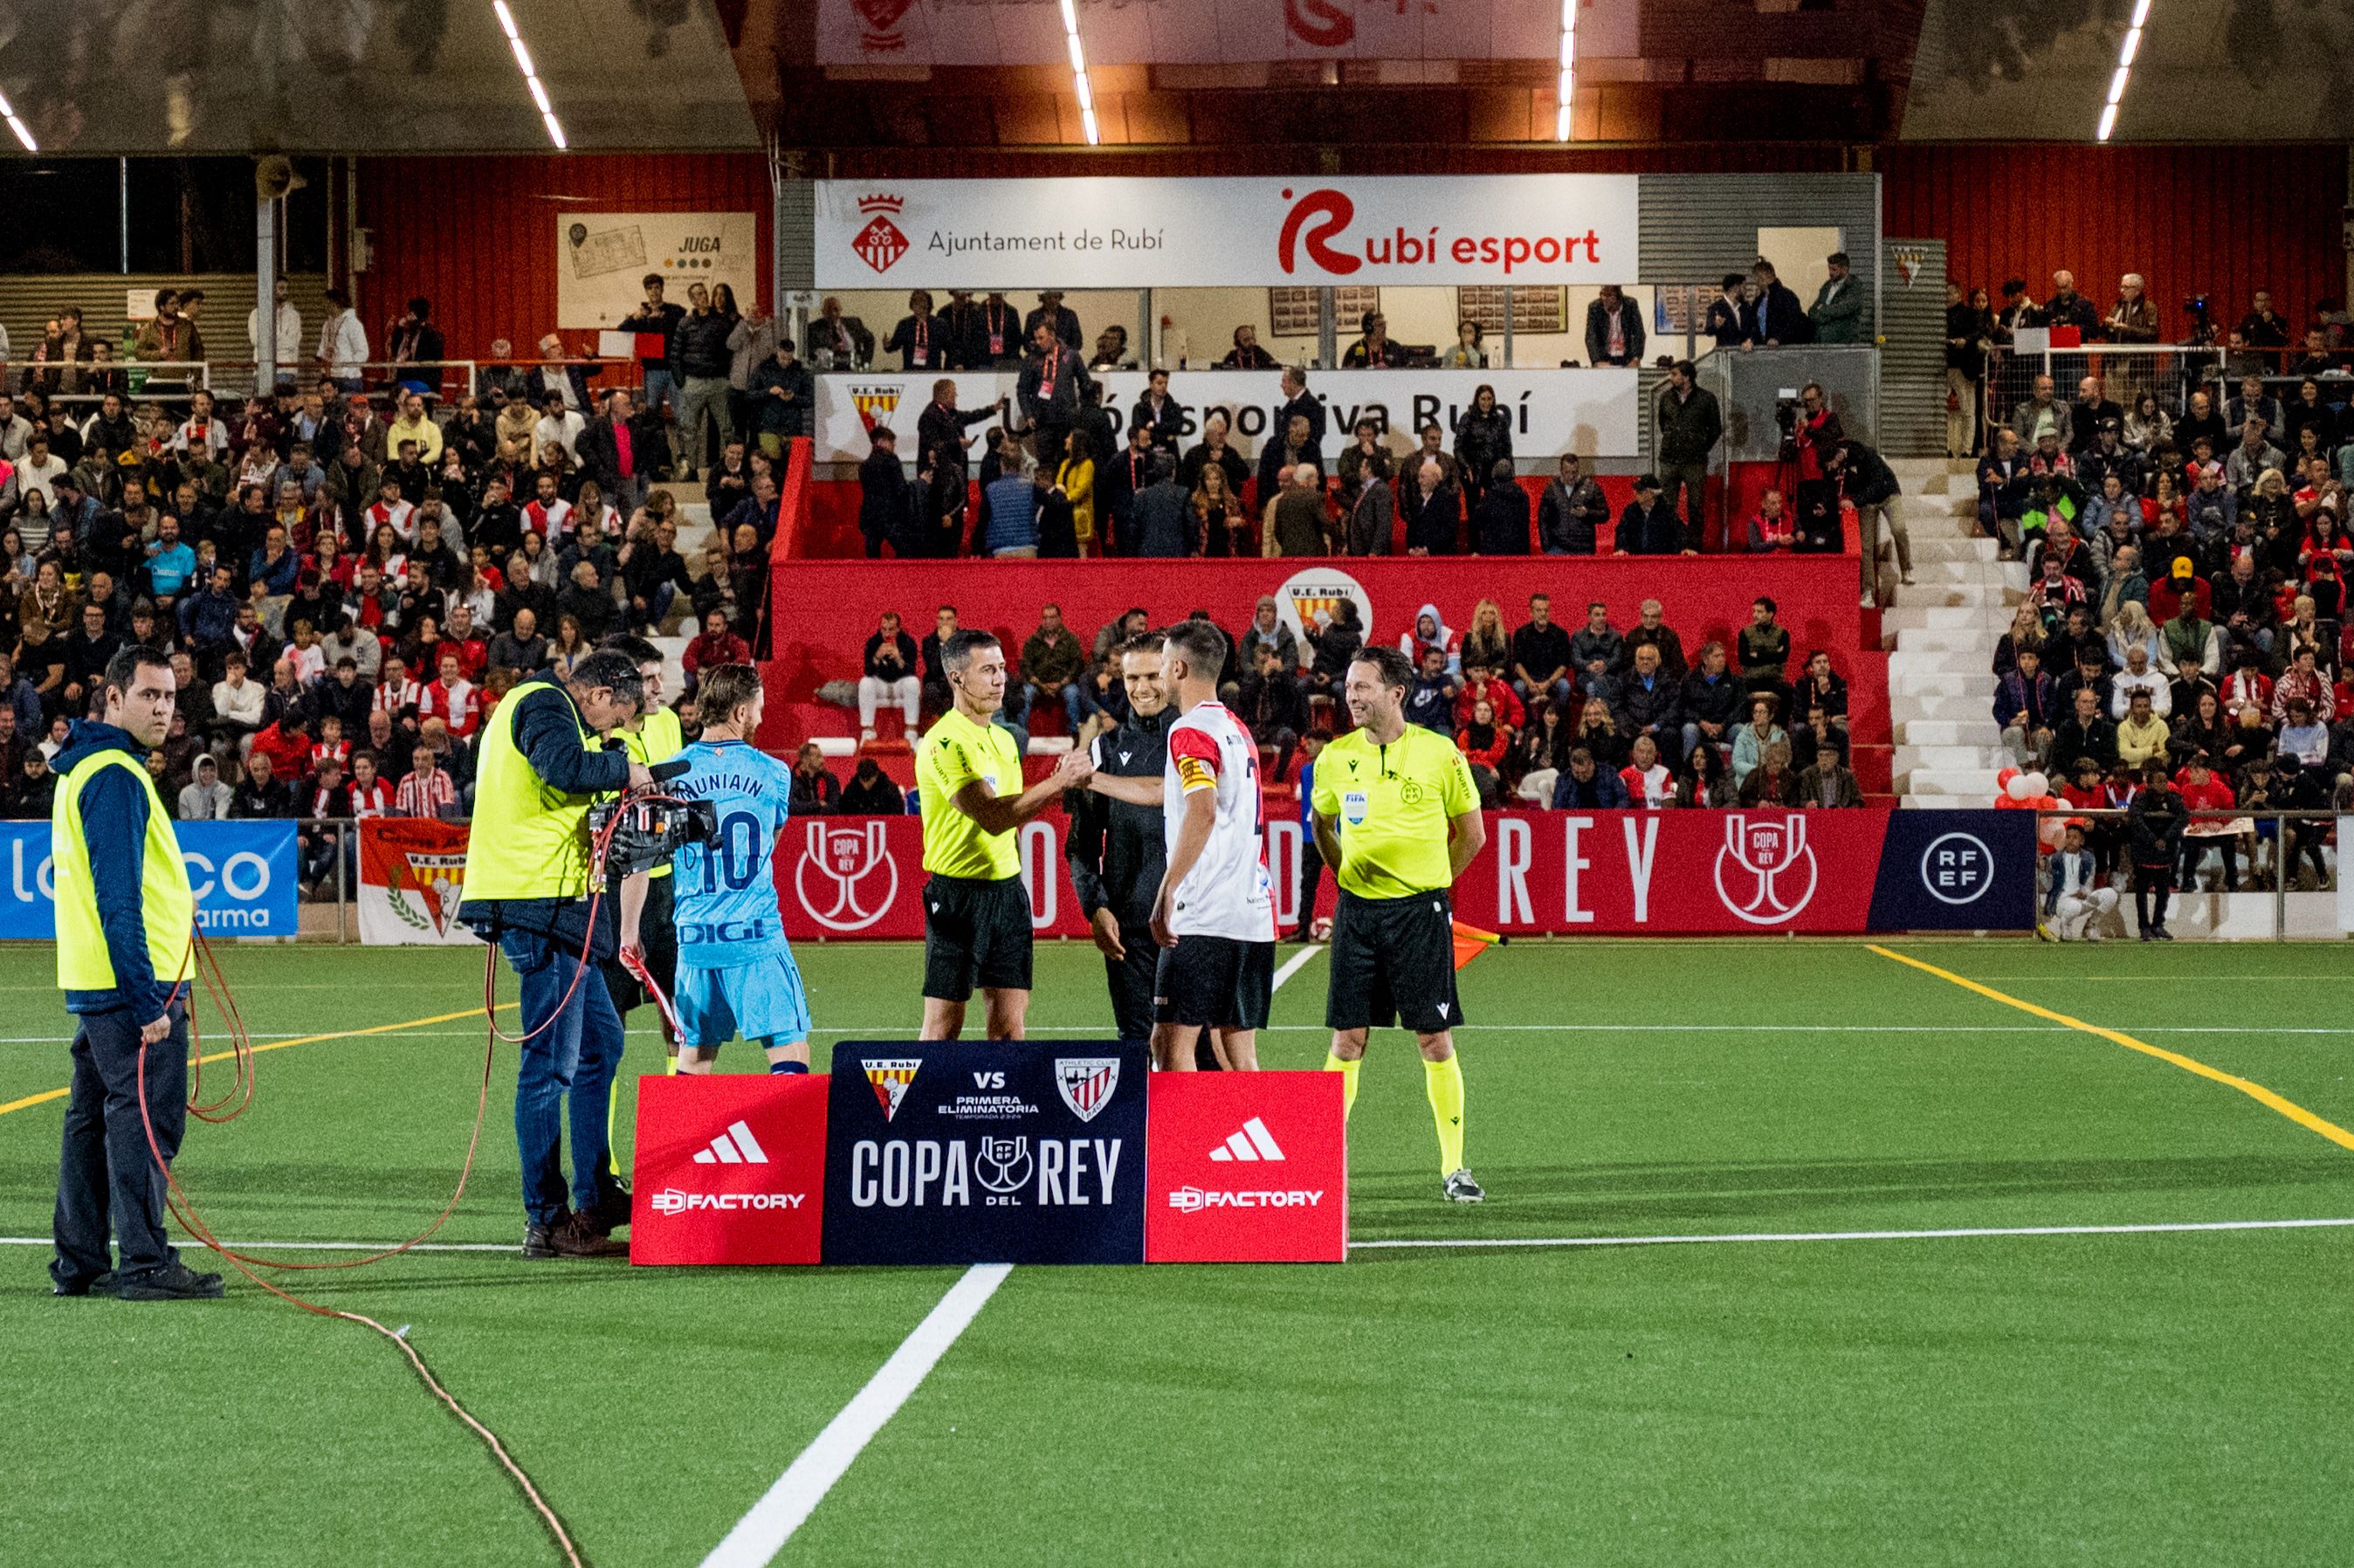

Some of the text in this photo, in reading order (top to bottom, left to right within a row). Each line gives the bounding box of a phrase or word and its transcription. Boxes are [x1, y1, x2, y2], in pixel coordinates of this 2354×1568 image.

[1278, 188, 1600, 275] Rubí esport
[678, 237, 720, 253] JUGA
[928, 229, 1164, 256] Ajuntament de Rubí
[834, 838, 859, 856] COPA
[1753, 832, 1779, 849] COPA
[439, 856, 467, 865] Rub
[702, 810, 761, 893] 10
[1497, 817, 1659, 925] REY
[974, 1072, 1006, 1090] VS
[938, 1104, 1040, 1114] ELIMINATORIA
[956, 1096, 1022, 1105] PRIMERA
[851, 1139, 970, 1207] COPA
[1038, 1138, 1122, 1206] REY
[985, 1195, 1022, 1207] DEL
